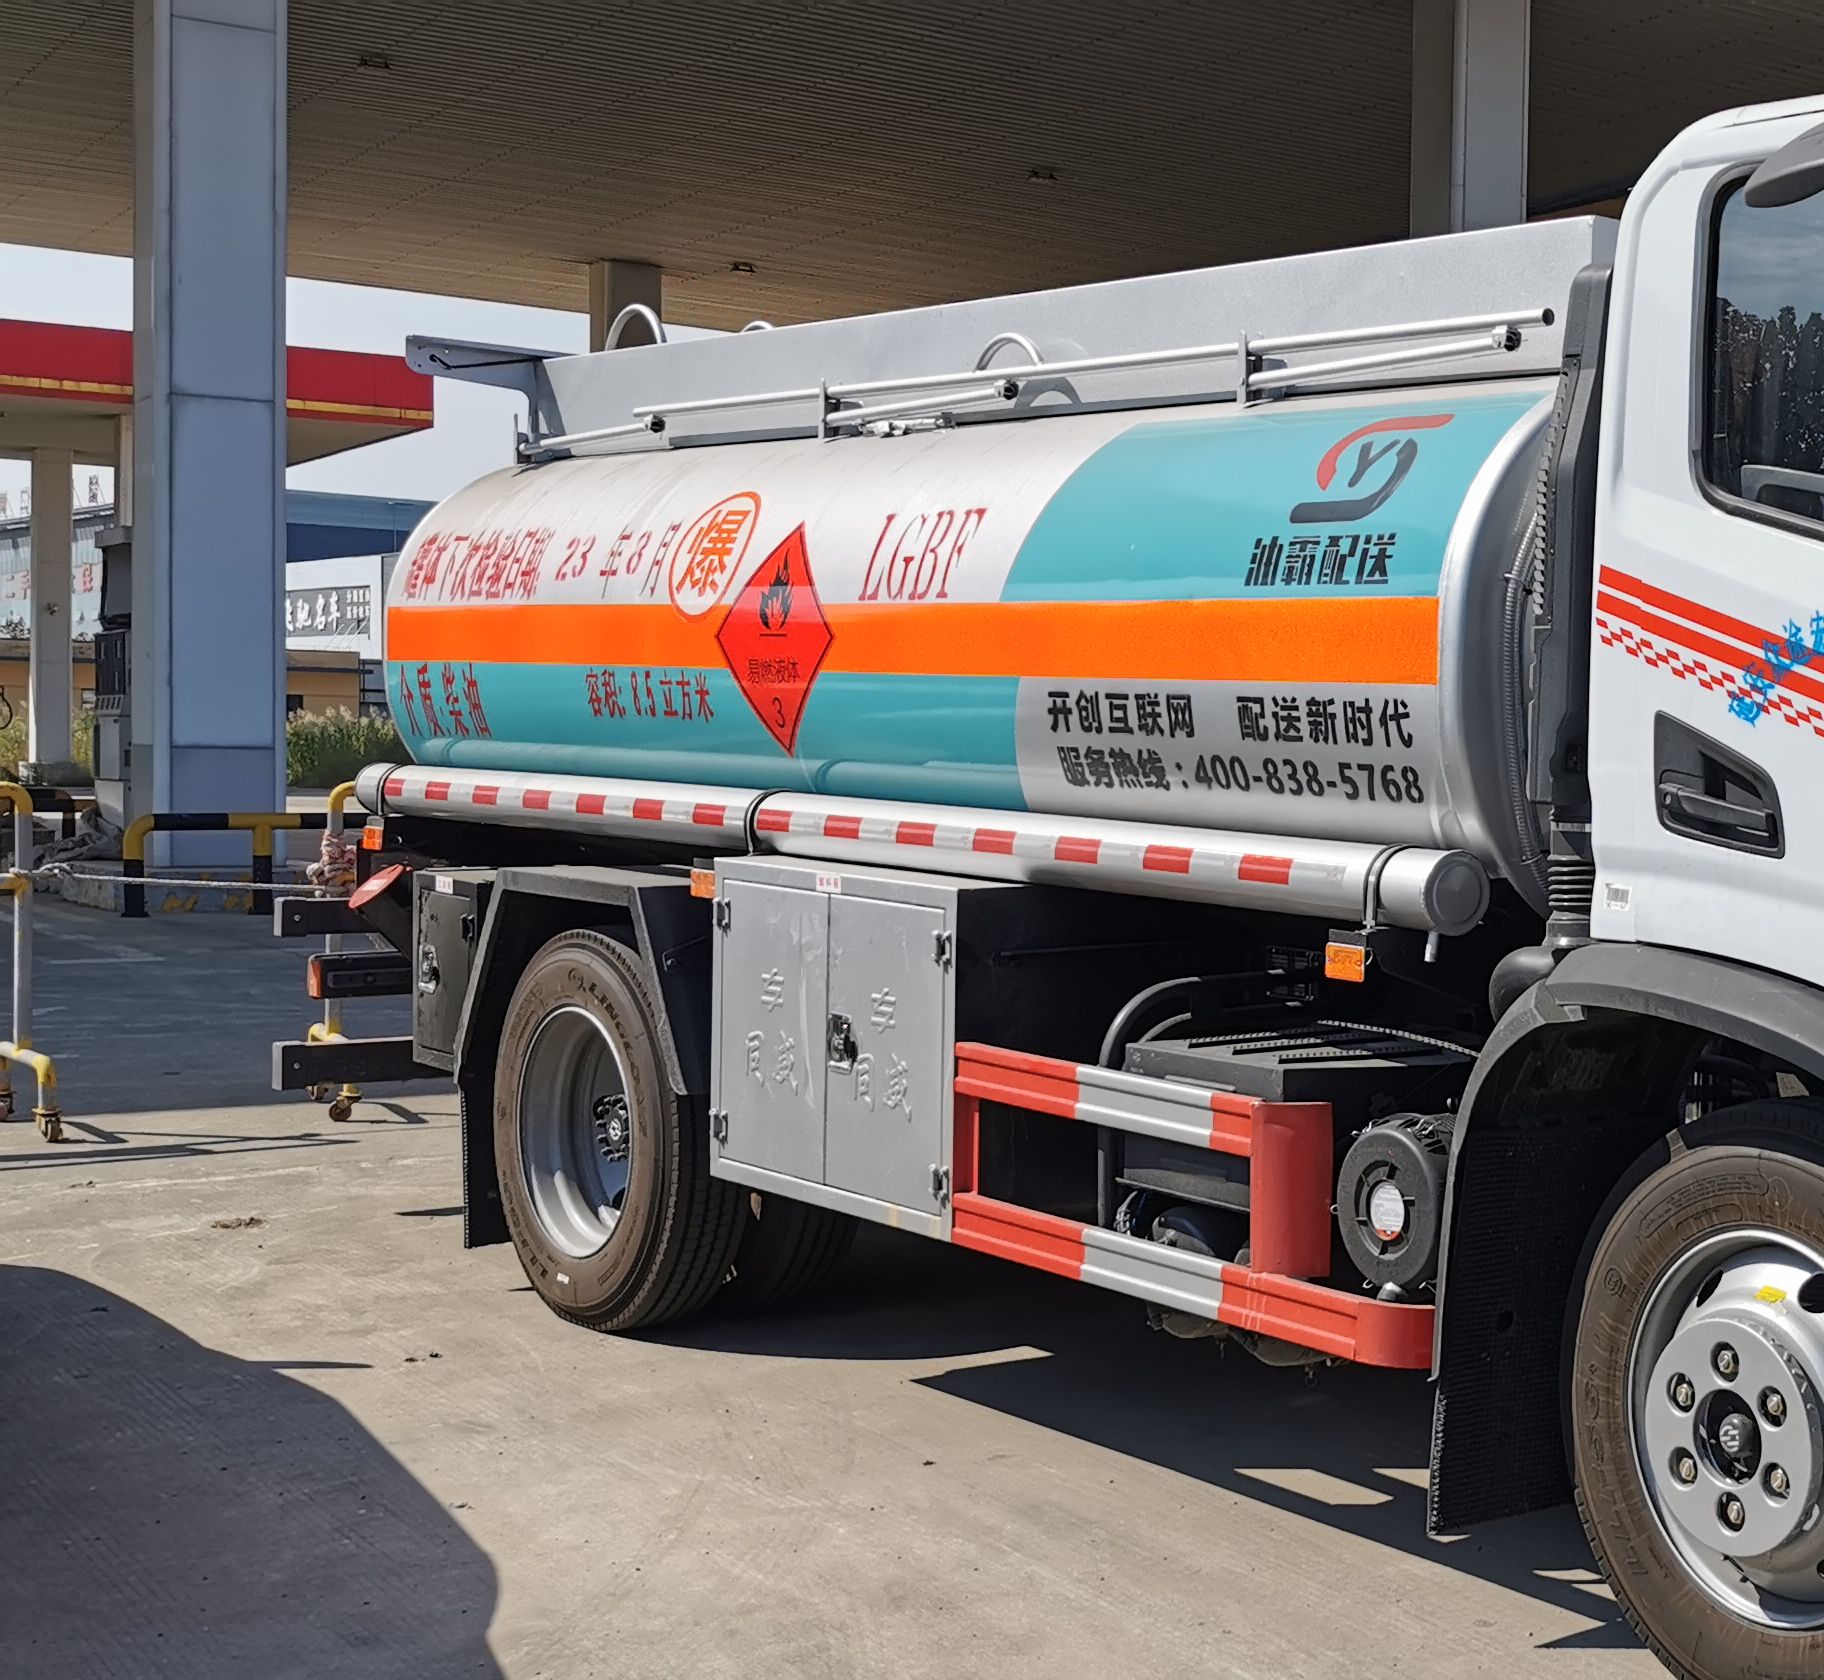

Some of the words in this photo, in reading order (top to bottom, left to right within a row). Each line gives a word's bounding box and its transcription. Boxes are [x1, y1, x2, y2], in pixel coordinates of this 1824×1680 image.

[675, 509, 753, 597] 爆
[858, 508, 987, 600] LGBF
[1244, 532, 1398, 587] 油霸配送
[747, 655, 801, 685] 易燃液体
[771, 696, 786, 729] 3
[1047, 690, 1196, 738] 开创互联网
[1236, 695, 1413, 748] 配送新时代
